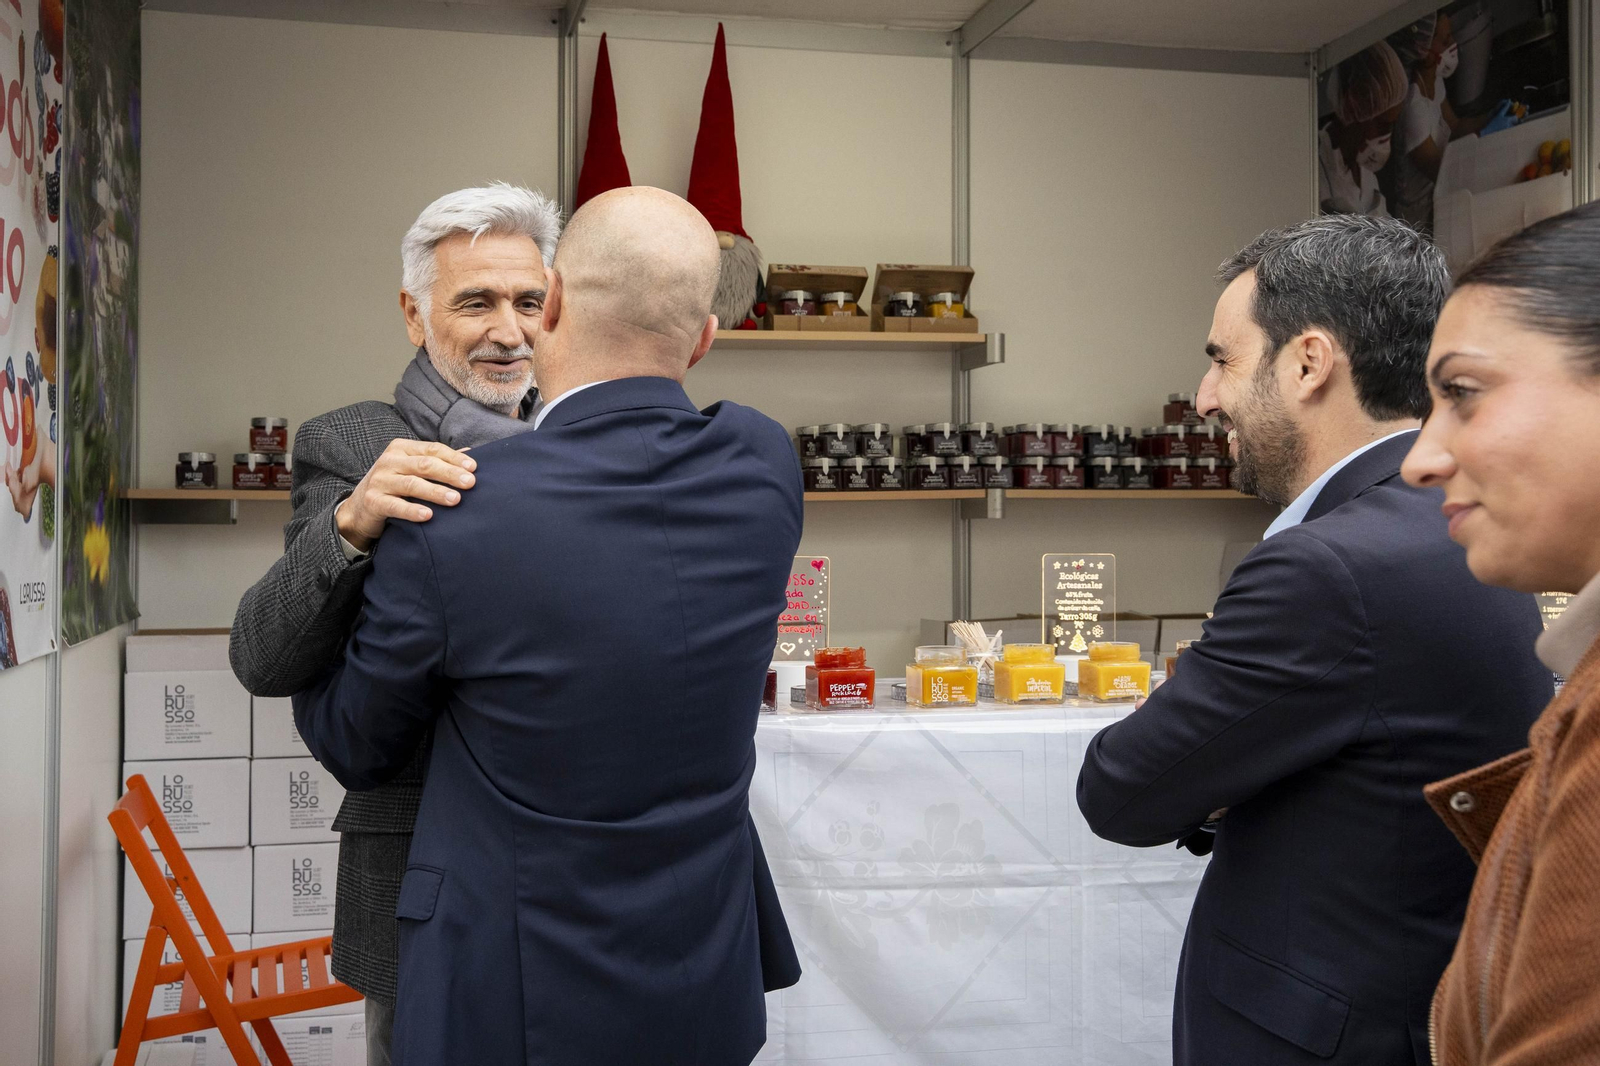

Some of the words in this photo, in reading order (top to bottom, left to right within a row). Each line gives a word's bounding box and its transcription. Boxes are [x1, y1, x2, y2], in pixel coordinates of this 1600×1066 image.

[1059, 572, 1099, 581] Ecológicas
[1056, 581, 1103, 590] Artesanales
[20, 581, 47, 605] LORUSSO
